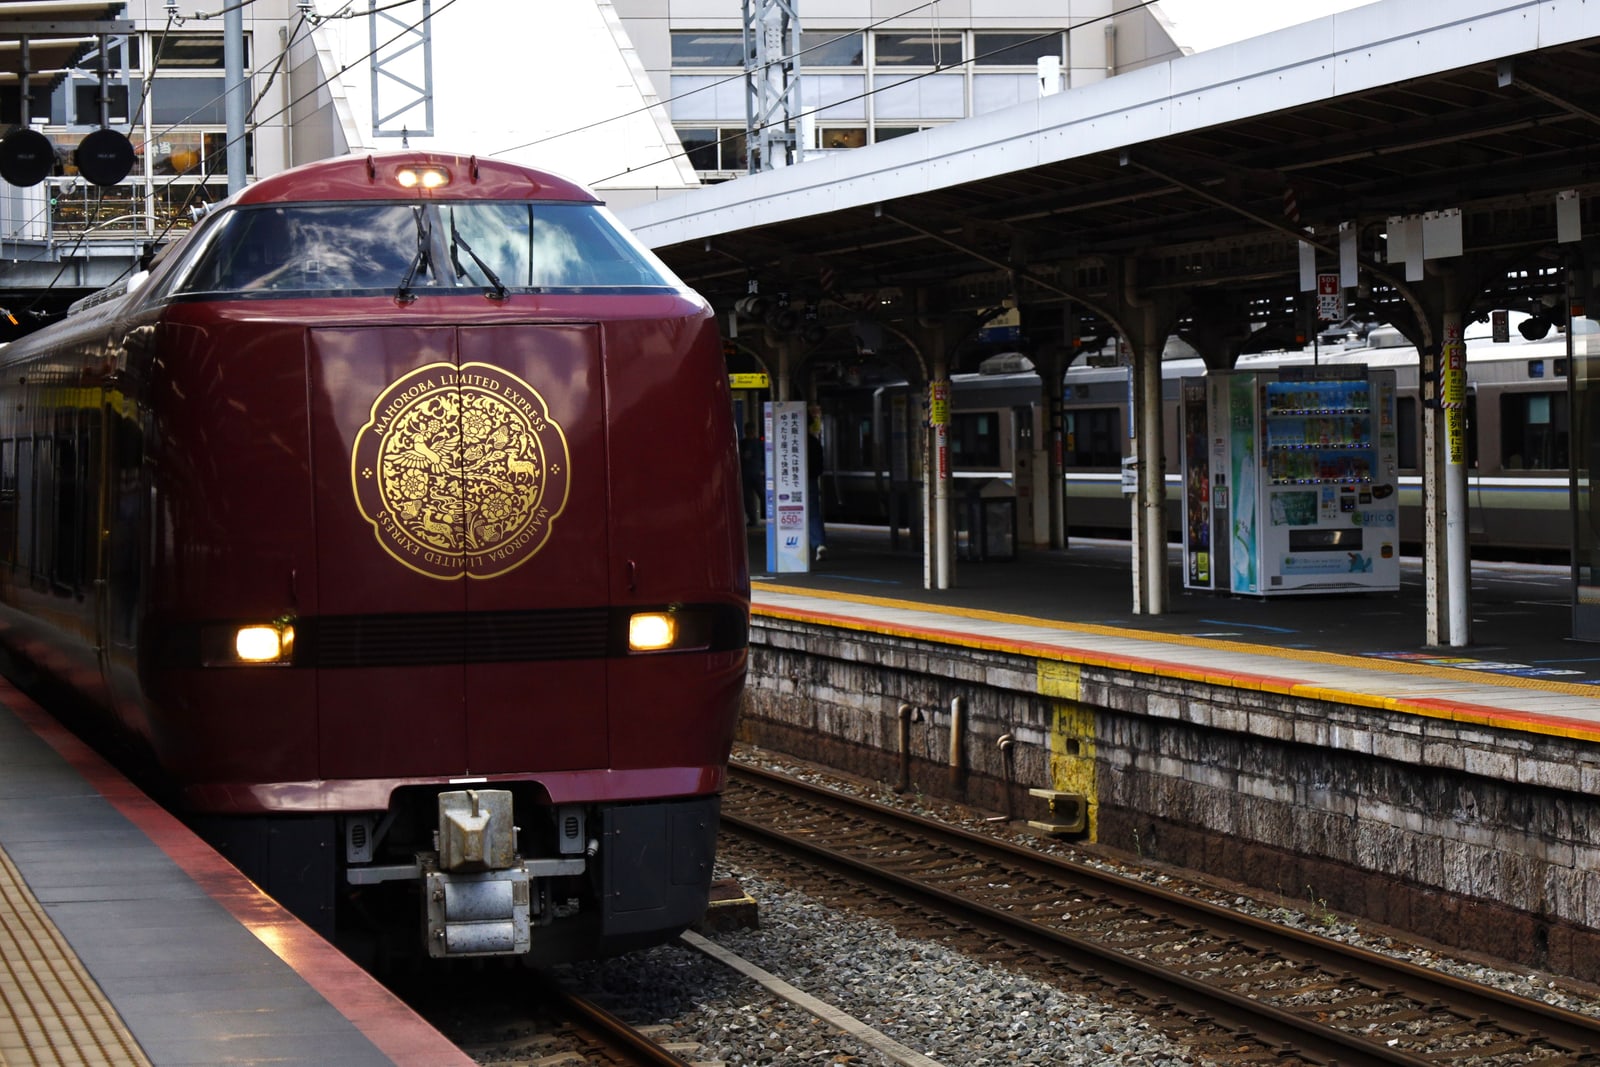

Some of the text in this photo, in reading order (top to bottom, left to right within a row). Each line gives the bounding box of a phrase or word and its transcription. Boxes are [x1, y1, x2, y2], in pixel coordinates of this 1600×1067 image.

[375, 375, 547, 436] MAHOROBA LIMITED EXPRESS
[376, 507, 550, 568] MAHOROBA LIMITED EXPRESS
